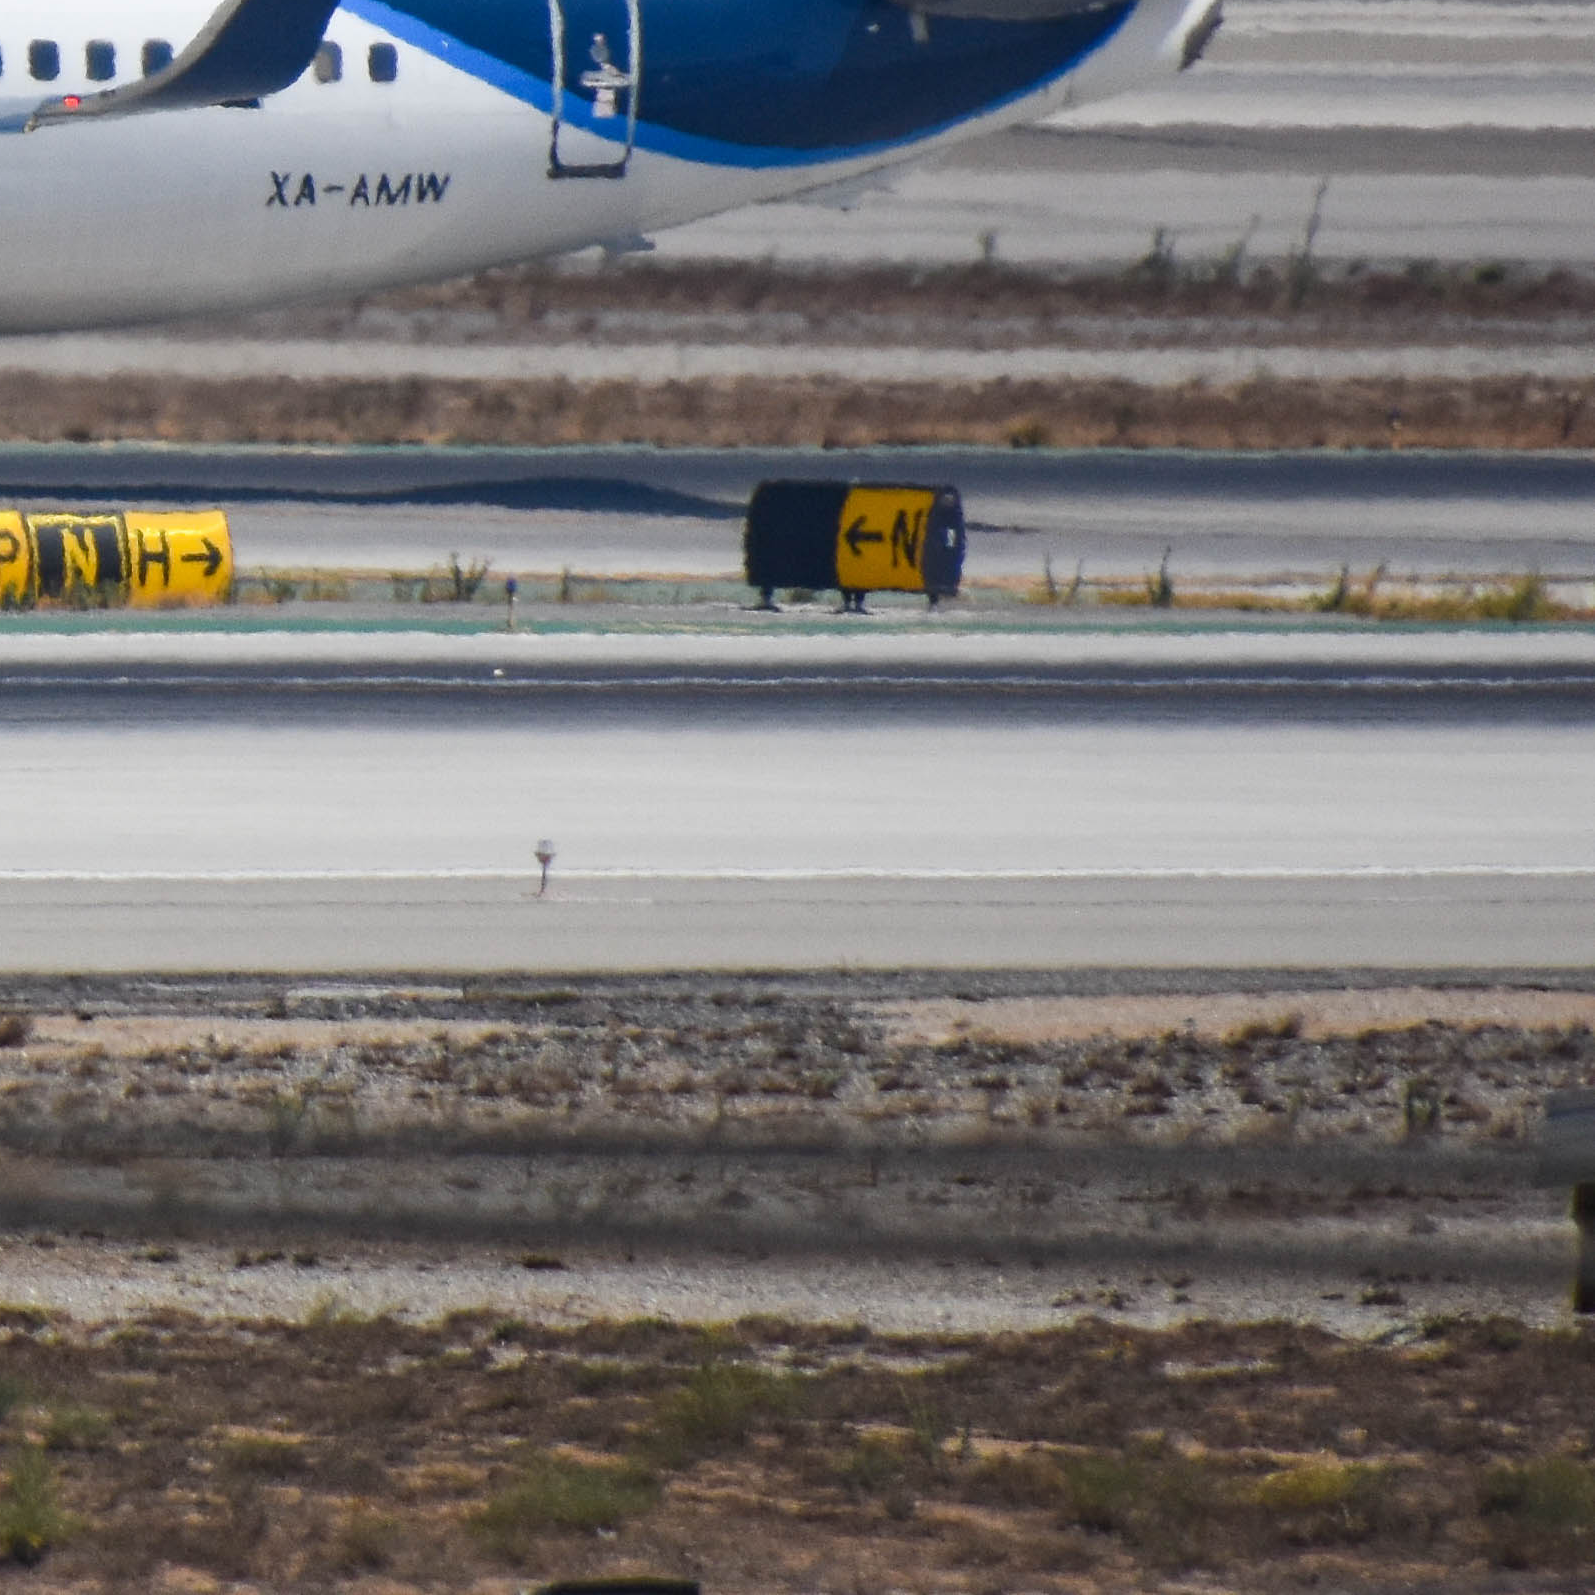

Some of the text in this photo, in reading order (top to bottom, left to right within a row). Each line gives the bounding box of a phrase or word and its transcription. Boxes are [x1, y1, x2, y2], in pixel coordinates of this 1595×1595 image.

[265, 170, 451, 208] XA-AMW
[62, 527, 99, 588] N
[138, 529, 172, 588] H
[891, 508, 923, 569] N
